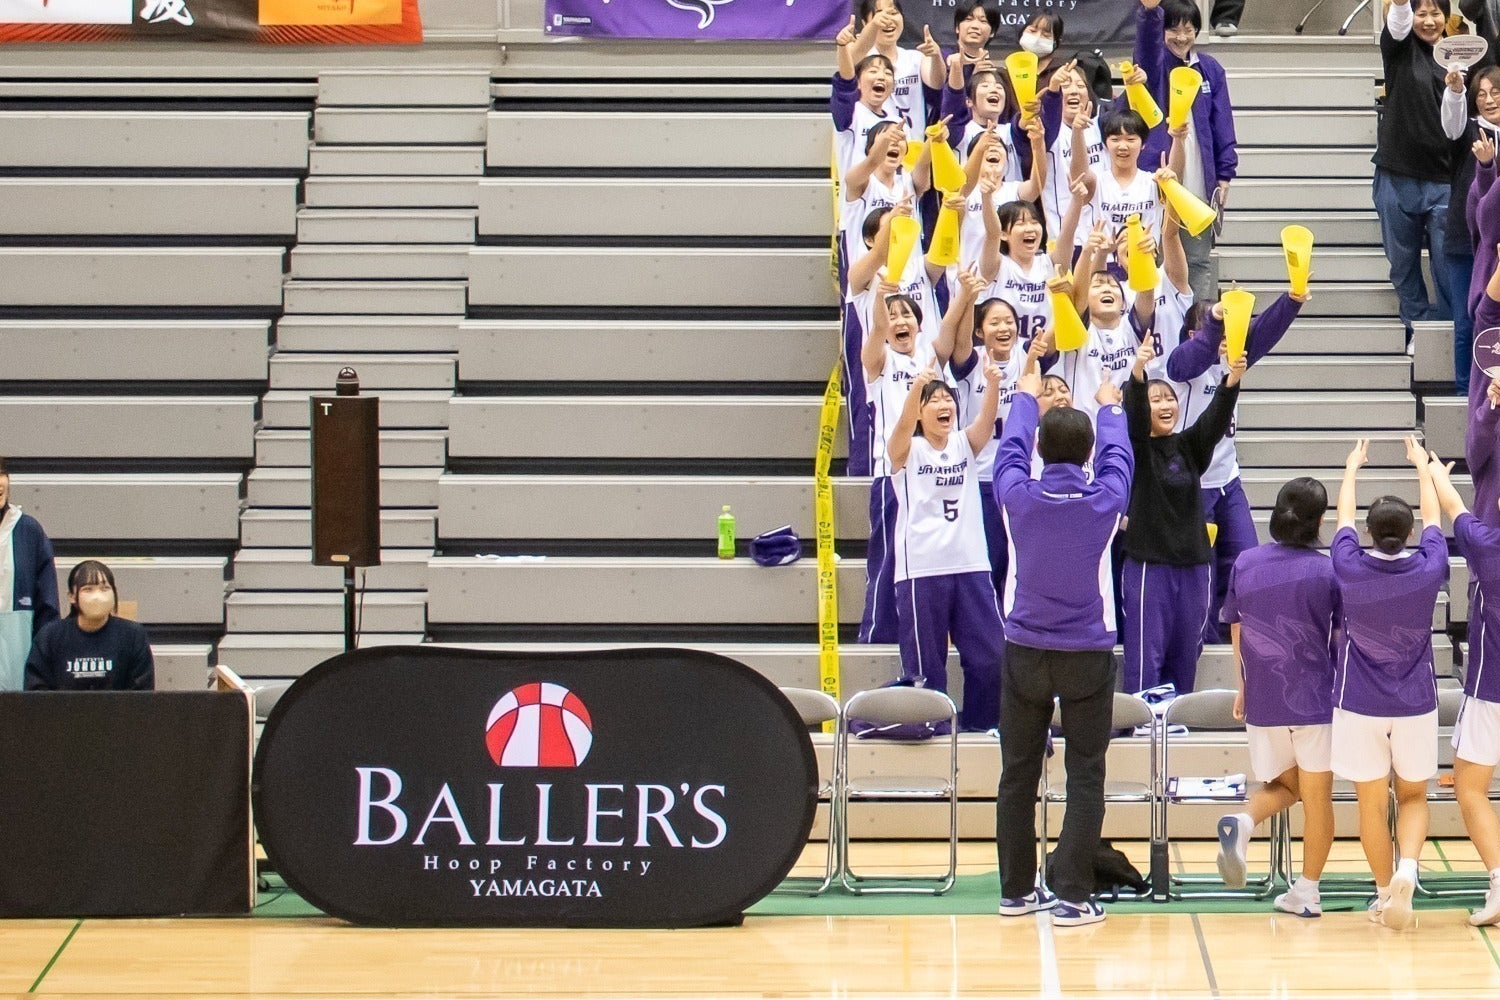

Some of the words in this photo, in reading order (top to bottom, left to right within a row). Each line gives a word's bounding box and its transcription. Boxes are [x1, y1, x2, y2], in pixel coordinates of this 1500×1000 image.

[935, 475, 964, 487] CHUO
[942, 499, 959, 522] 5
[353, 766, 728, 848] BALLER'S
[423, 855, 503, 874] Hoop
[527, 855, 655, 874] Factory
[469, 880, 603, 898] YAMAGATA
